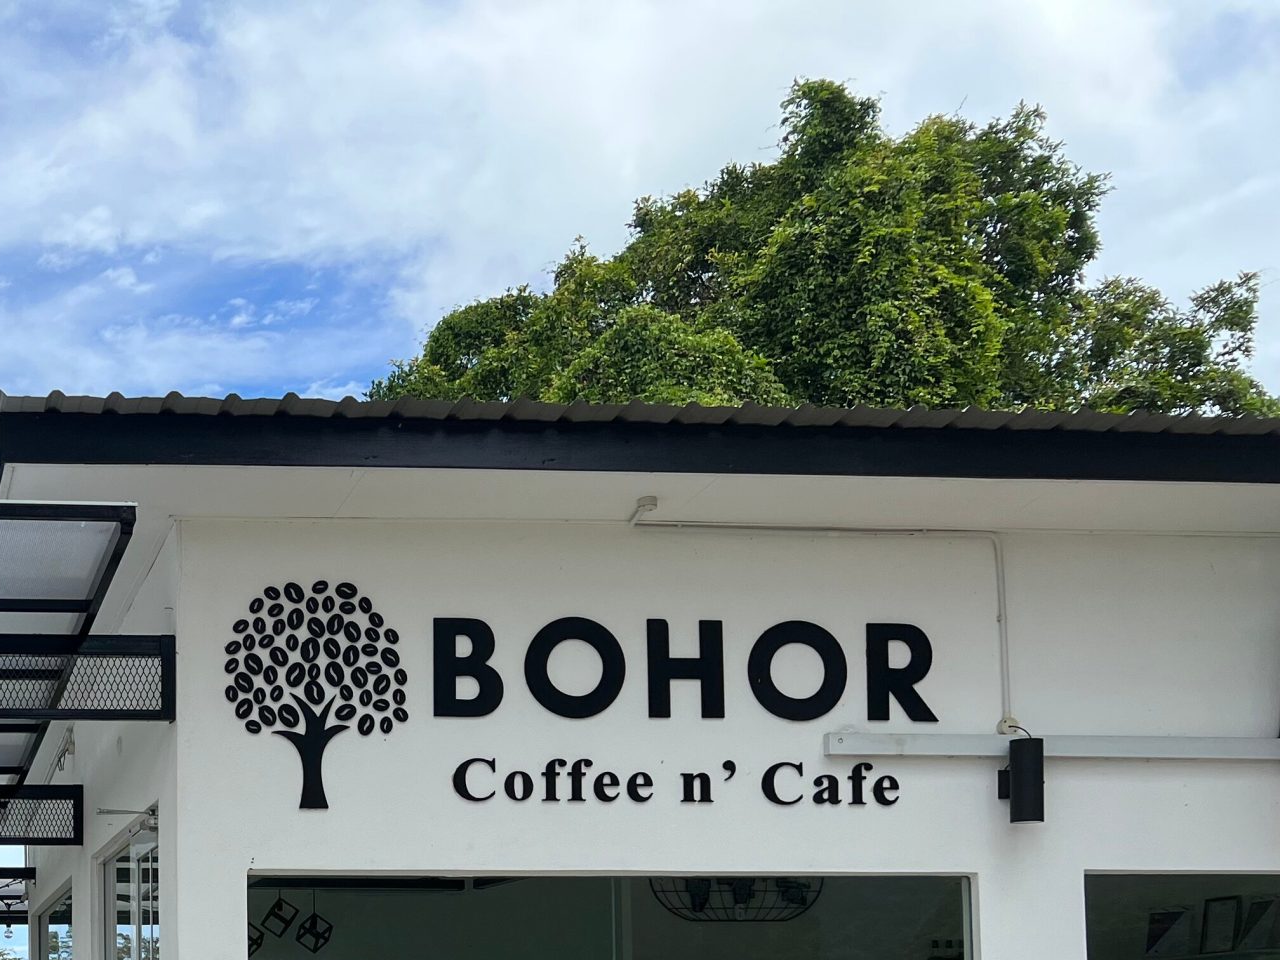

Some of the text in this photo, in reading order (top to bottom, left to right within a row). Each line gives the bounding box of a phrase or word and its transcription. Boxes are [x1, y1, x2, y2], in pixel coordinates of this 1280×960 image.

[433, 617, 939, 722] BOHOR
[453, 758, 653, 802] Coffee
[762, 762, 899, 806] Cafe
